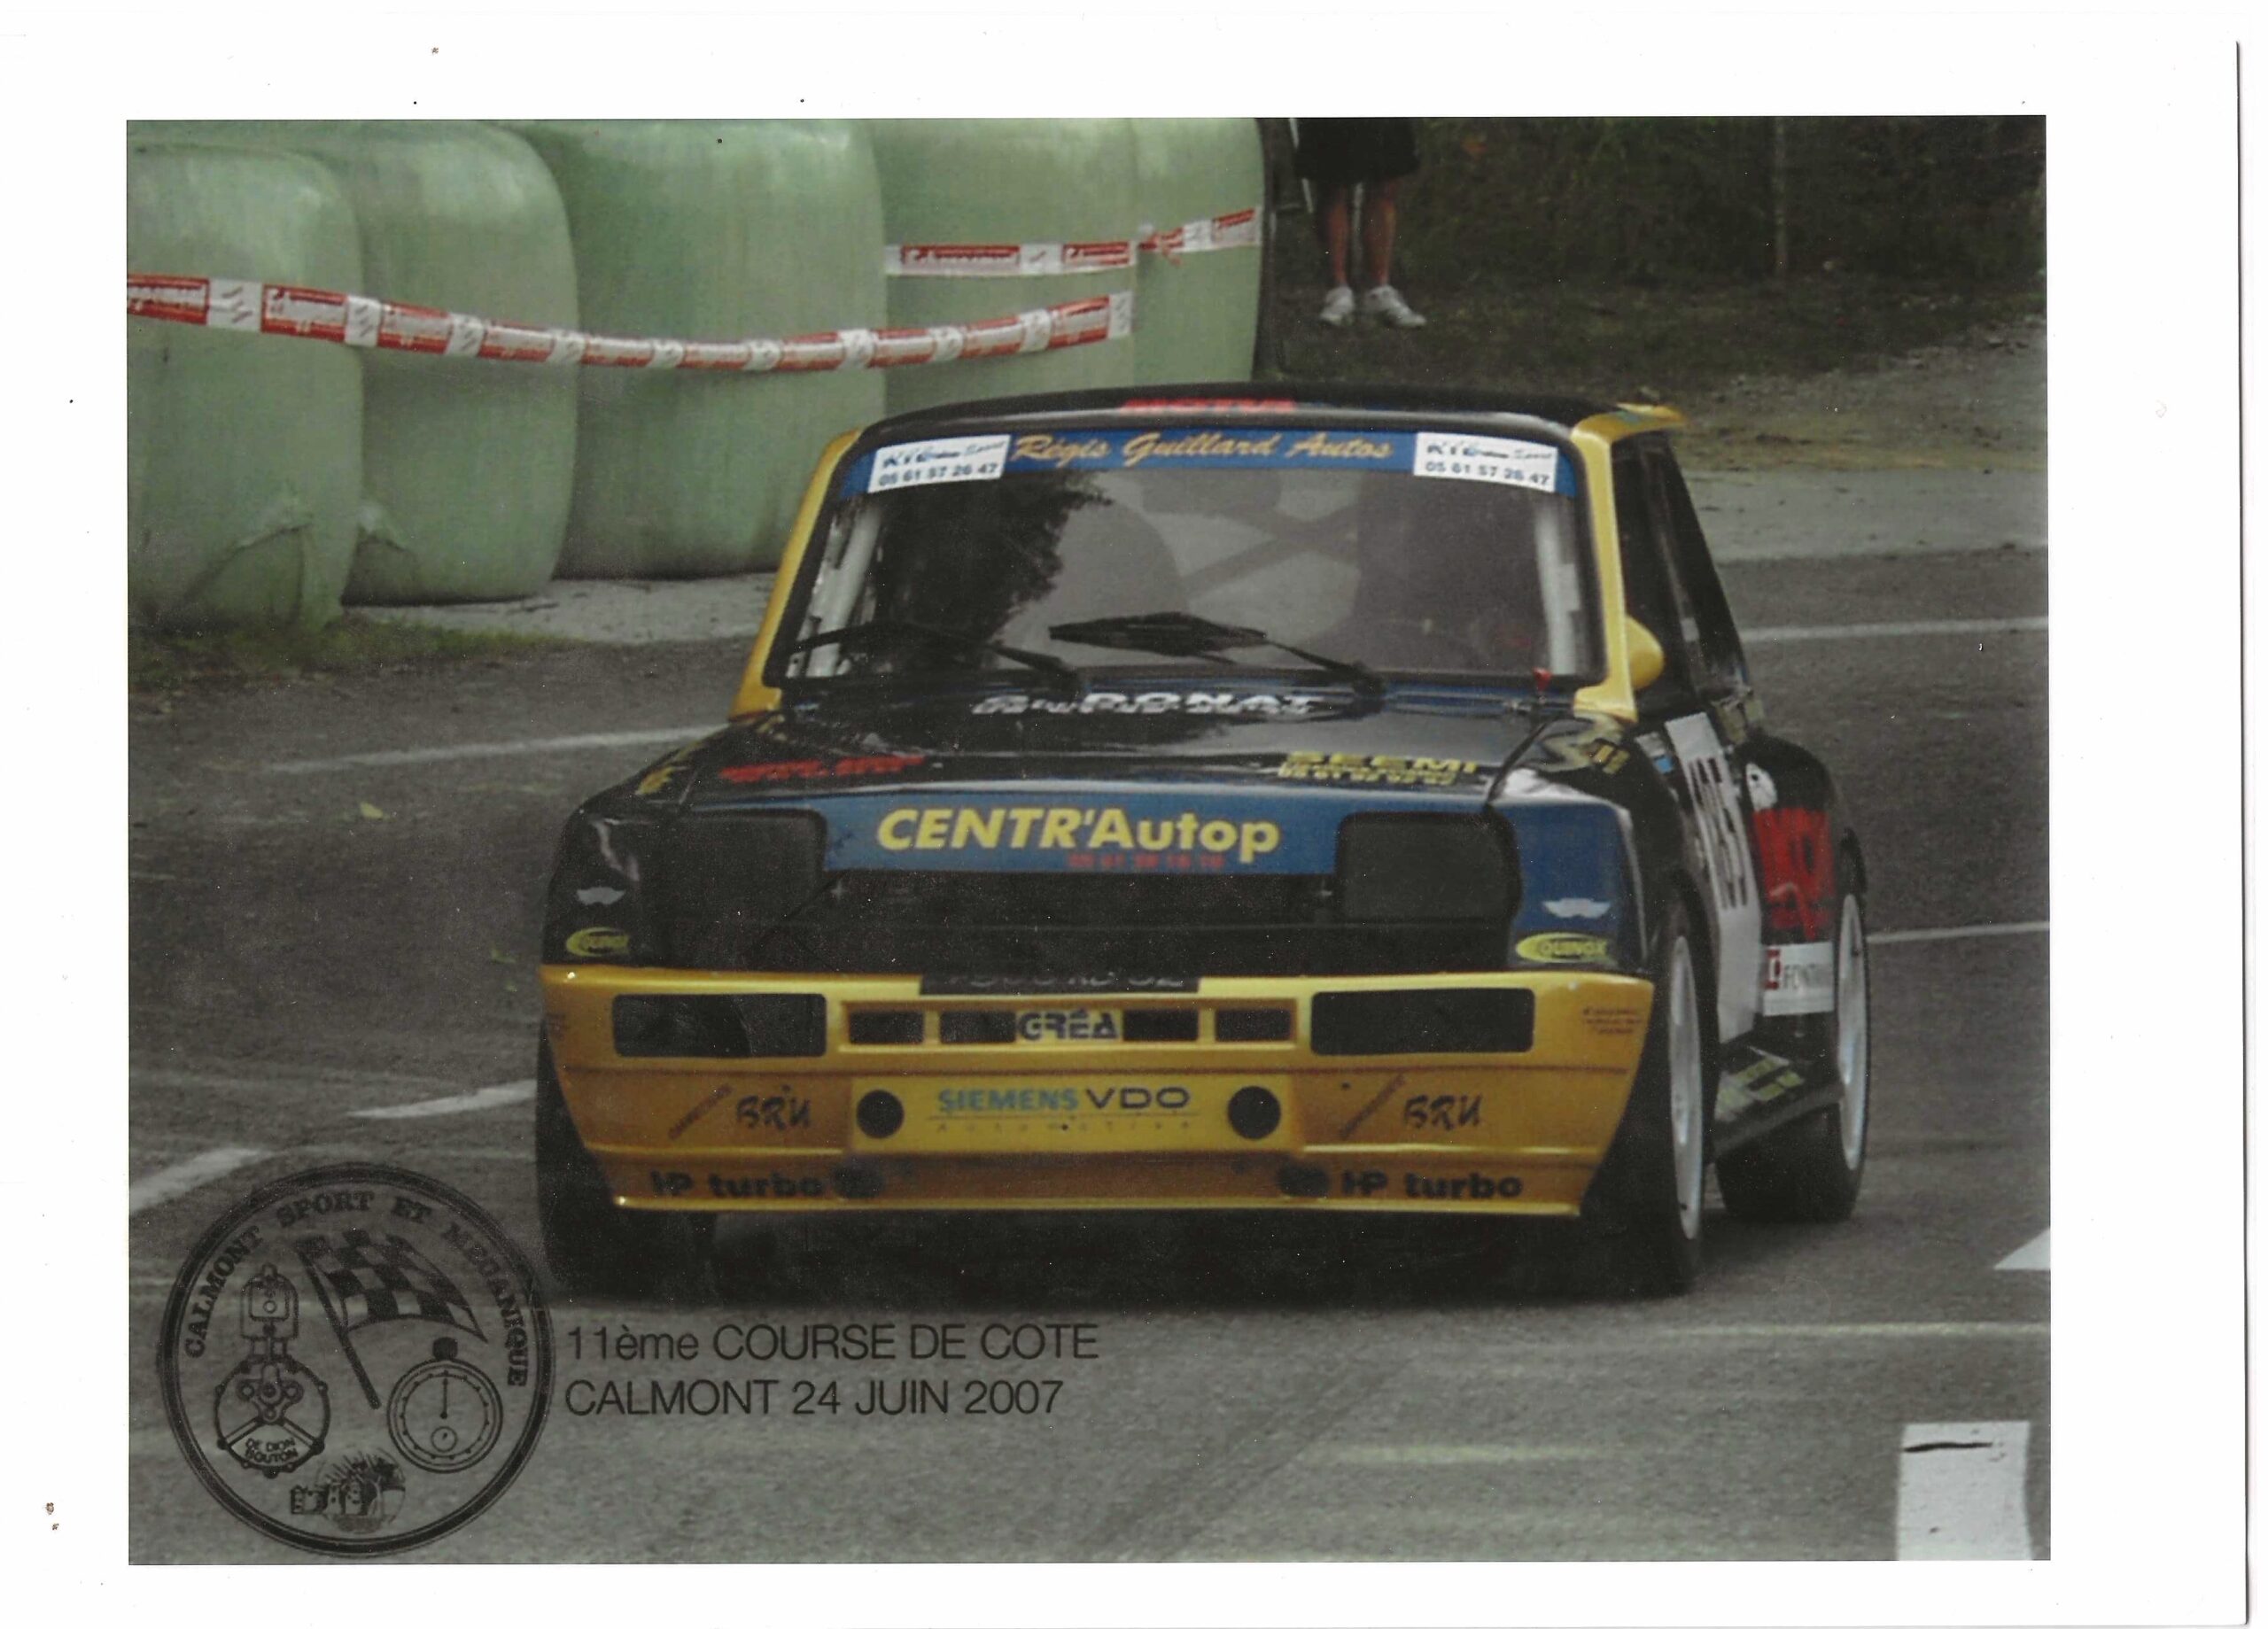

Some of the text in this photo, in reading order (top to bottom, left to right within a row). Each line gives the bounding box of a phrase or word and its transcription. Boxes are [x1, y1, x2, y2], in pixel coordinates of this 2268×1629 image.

[1011, 433, 1111, 468] Régis
[1124, 431, 1283, 467] Guillard
[1285, 434, 1394, 459] Autos
[903, 469, 921, 482] 61
[951, 463, 973, 477] 26
[977, 462, 998, 474] 47
[1425, 461, 1446, 473] 05
[1451, 462, 1471, 474] 61
[1478, 465, 1498, 477] 57
[1528, 473, 1550, 485] 47
[876, 807, 1281, 863] CENTR'Autop
[937, 1086, 1192, 1113] SIEMENS VDO
[649, 1169, 827, 1199] HP turbo
[1341, 1169, 1524, 1199] HP turbo
